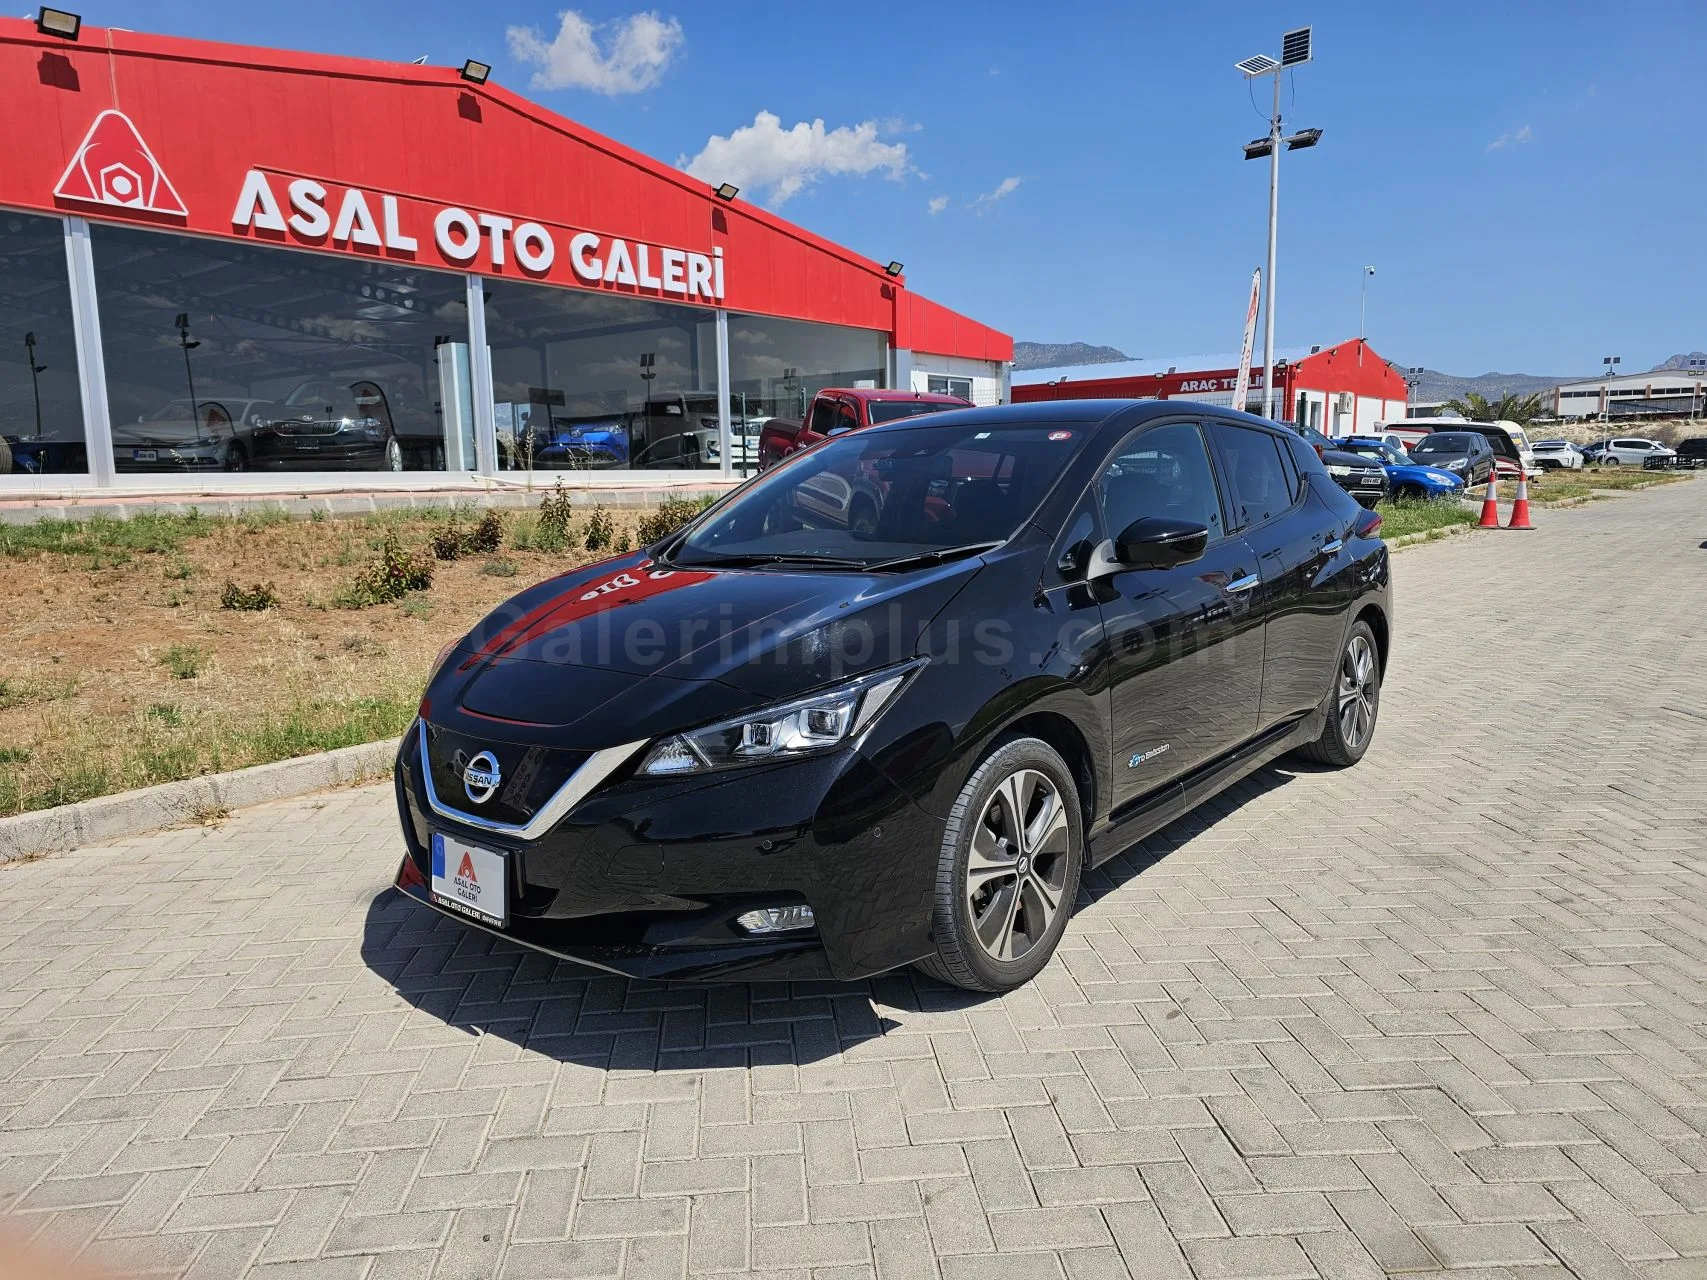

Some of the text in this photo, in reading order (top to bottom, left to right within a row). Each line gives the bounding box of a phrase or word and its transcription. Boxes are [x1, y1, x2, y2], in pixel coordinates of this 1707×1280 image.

[232, 170, 725, 299] ASAL OTO GALERİ
[1180, 374, 1264, 392] ARAÇ TELİ
[465, 771, 493, 786] ISSAN
[453, 876, 482, 895] ASAL OTO
[457, 887, 478, 902] GALERİ
[437, 896, 452, 908] ASAL
[451, 902, 462, 912] OTO
